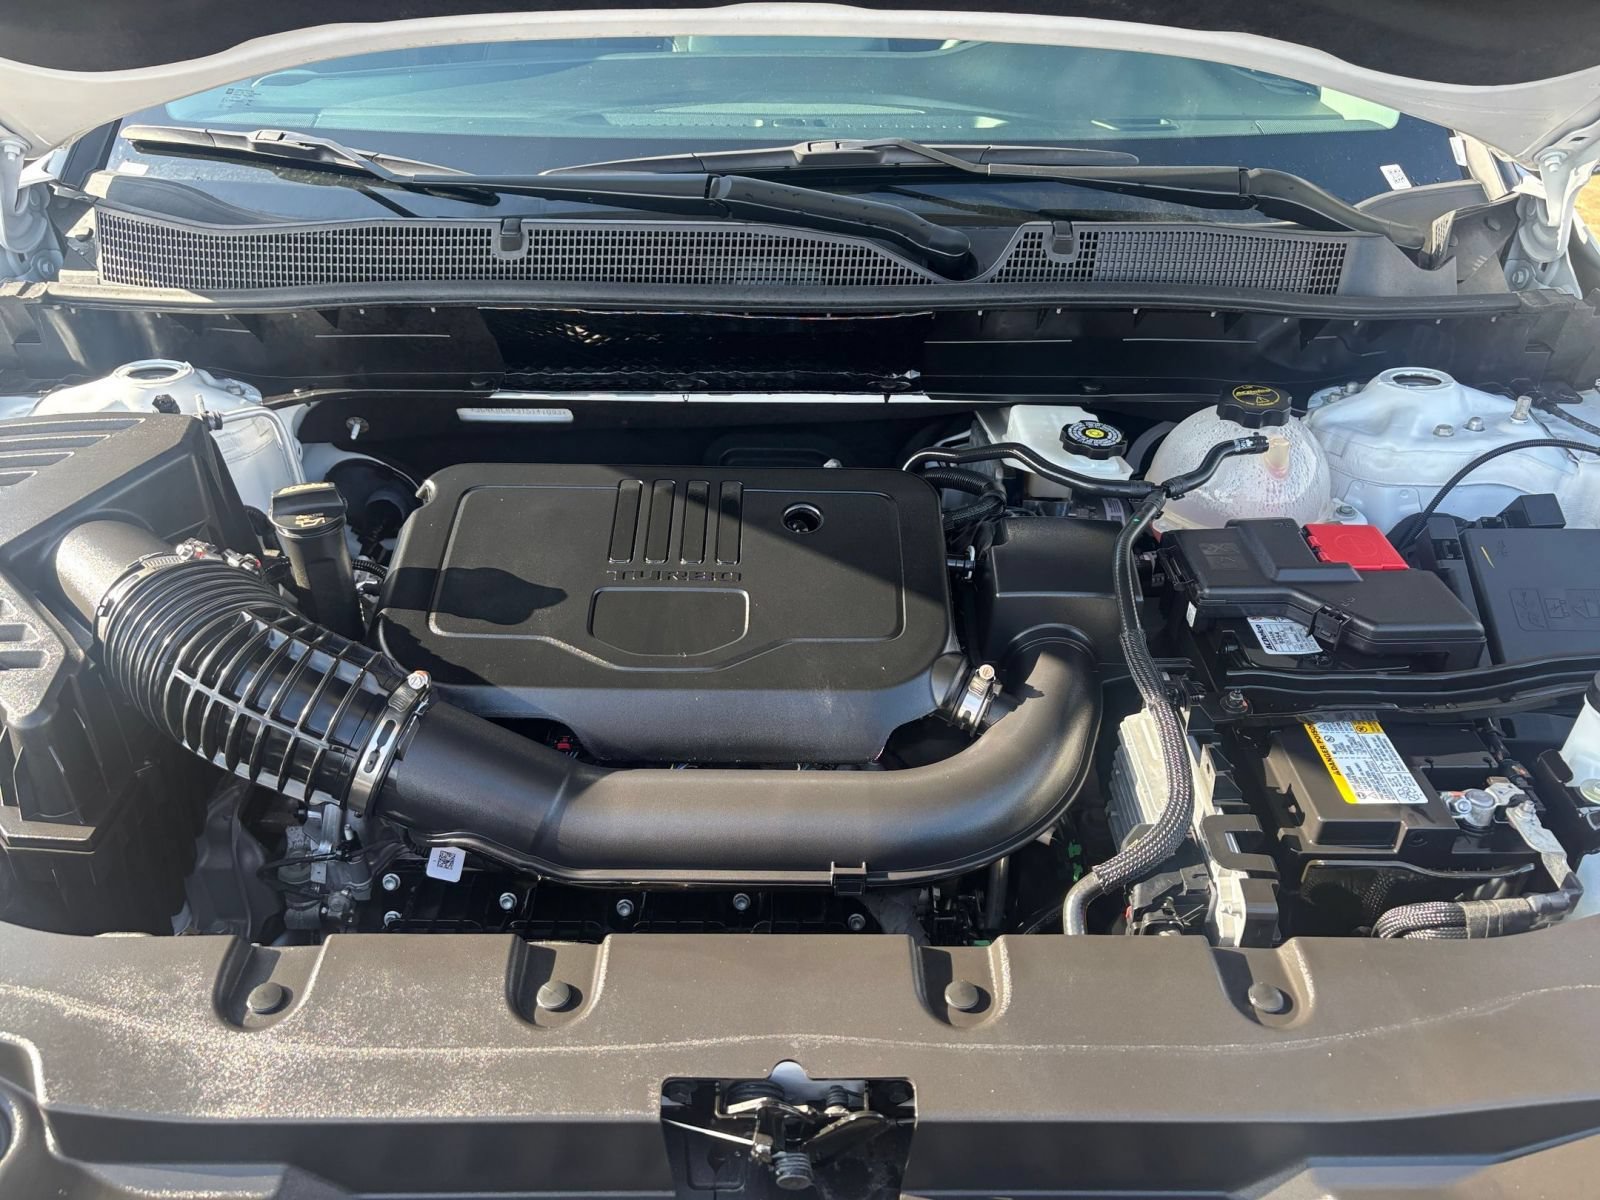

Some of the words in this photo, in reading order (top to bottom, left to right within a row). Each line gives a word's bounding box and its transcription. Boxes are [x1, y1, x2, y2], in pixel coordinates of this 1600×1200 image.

[606, 570, 741, 581] TURBO
[1255, 624, 1274, 651] ACDelco
[1319, 745, 1338, 771] DANGER
